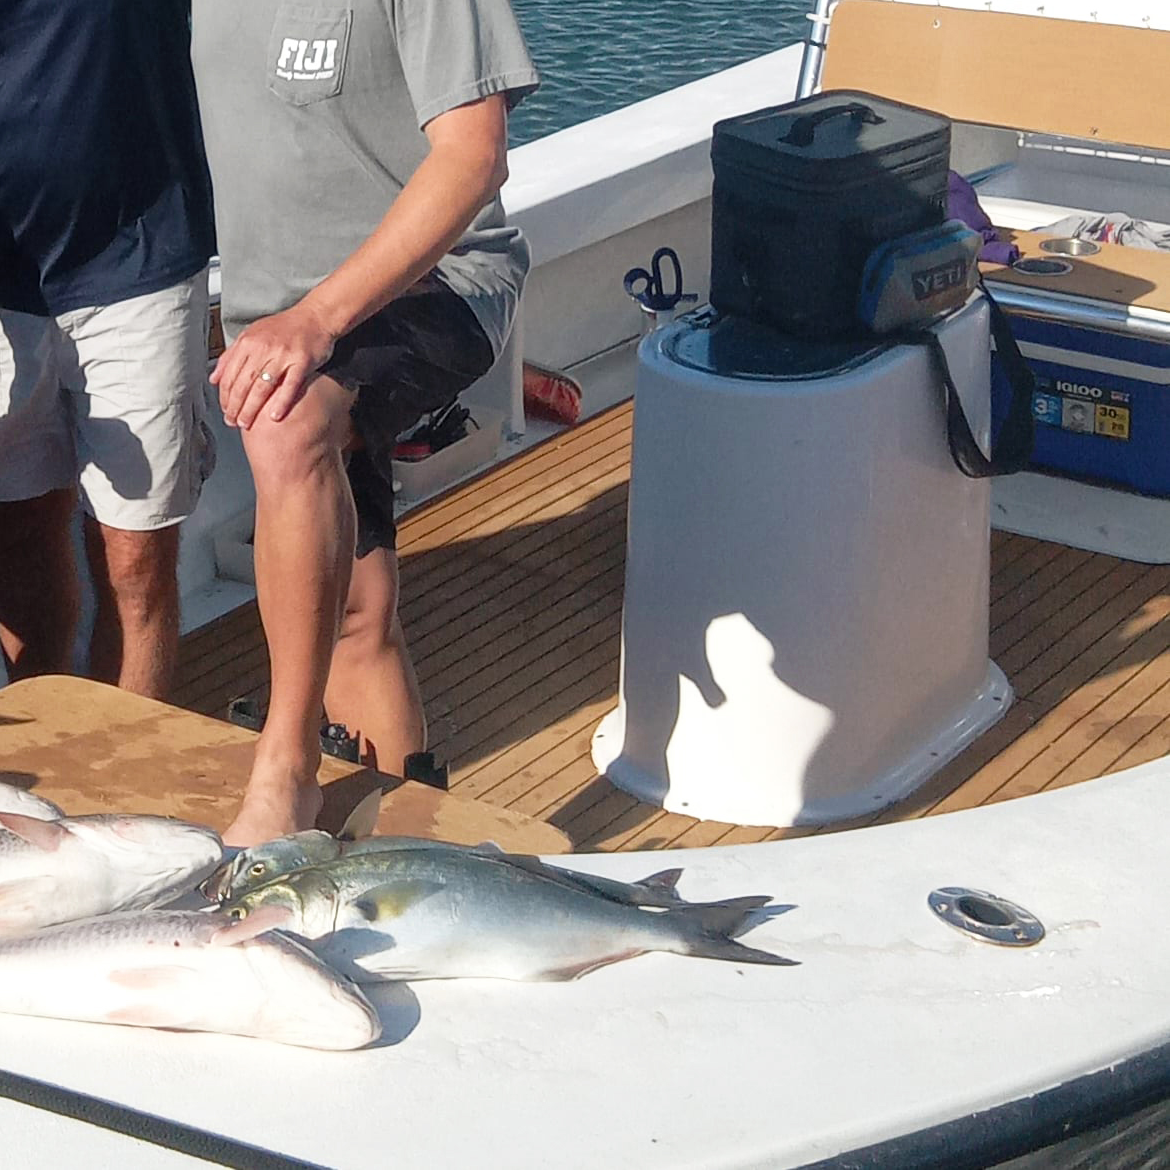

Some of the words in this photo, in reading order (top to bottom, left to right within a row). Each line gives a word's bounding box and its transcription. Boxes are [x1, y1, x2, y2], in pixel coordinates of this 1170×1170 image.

[277, 37, 338, 71] FIJI
[916, 265, 961, 293] YETI
[1056, 380, 1103, 398] IGLOO
